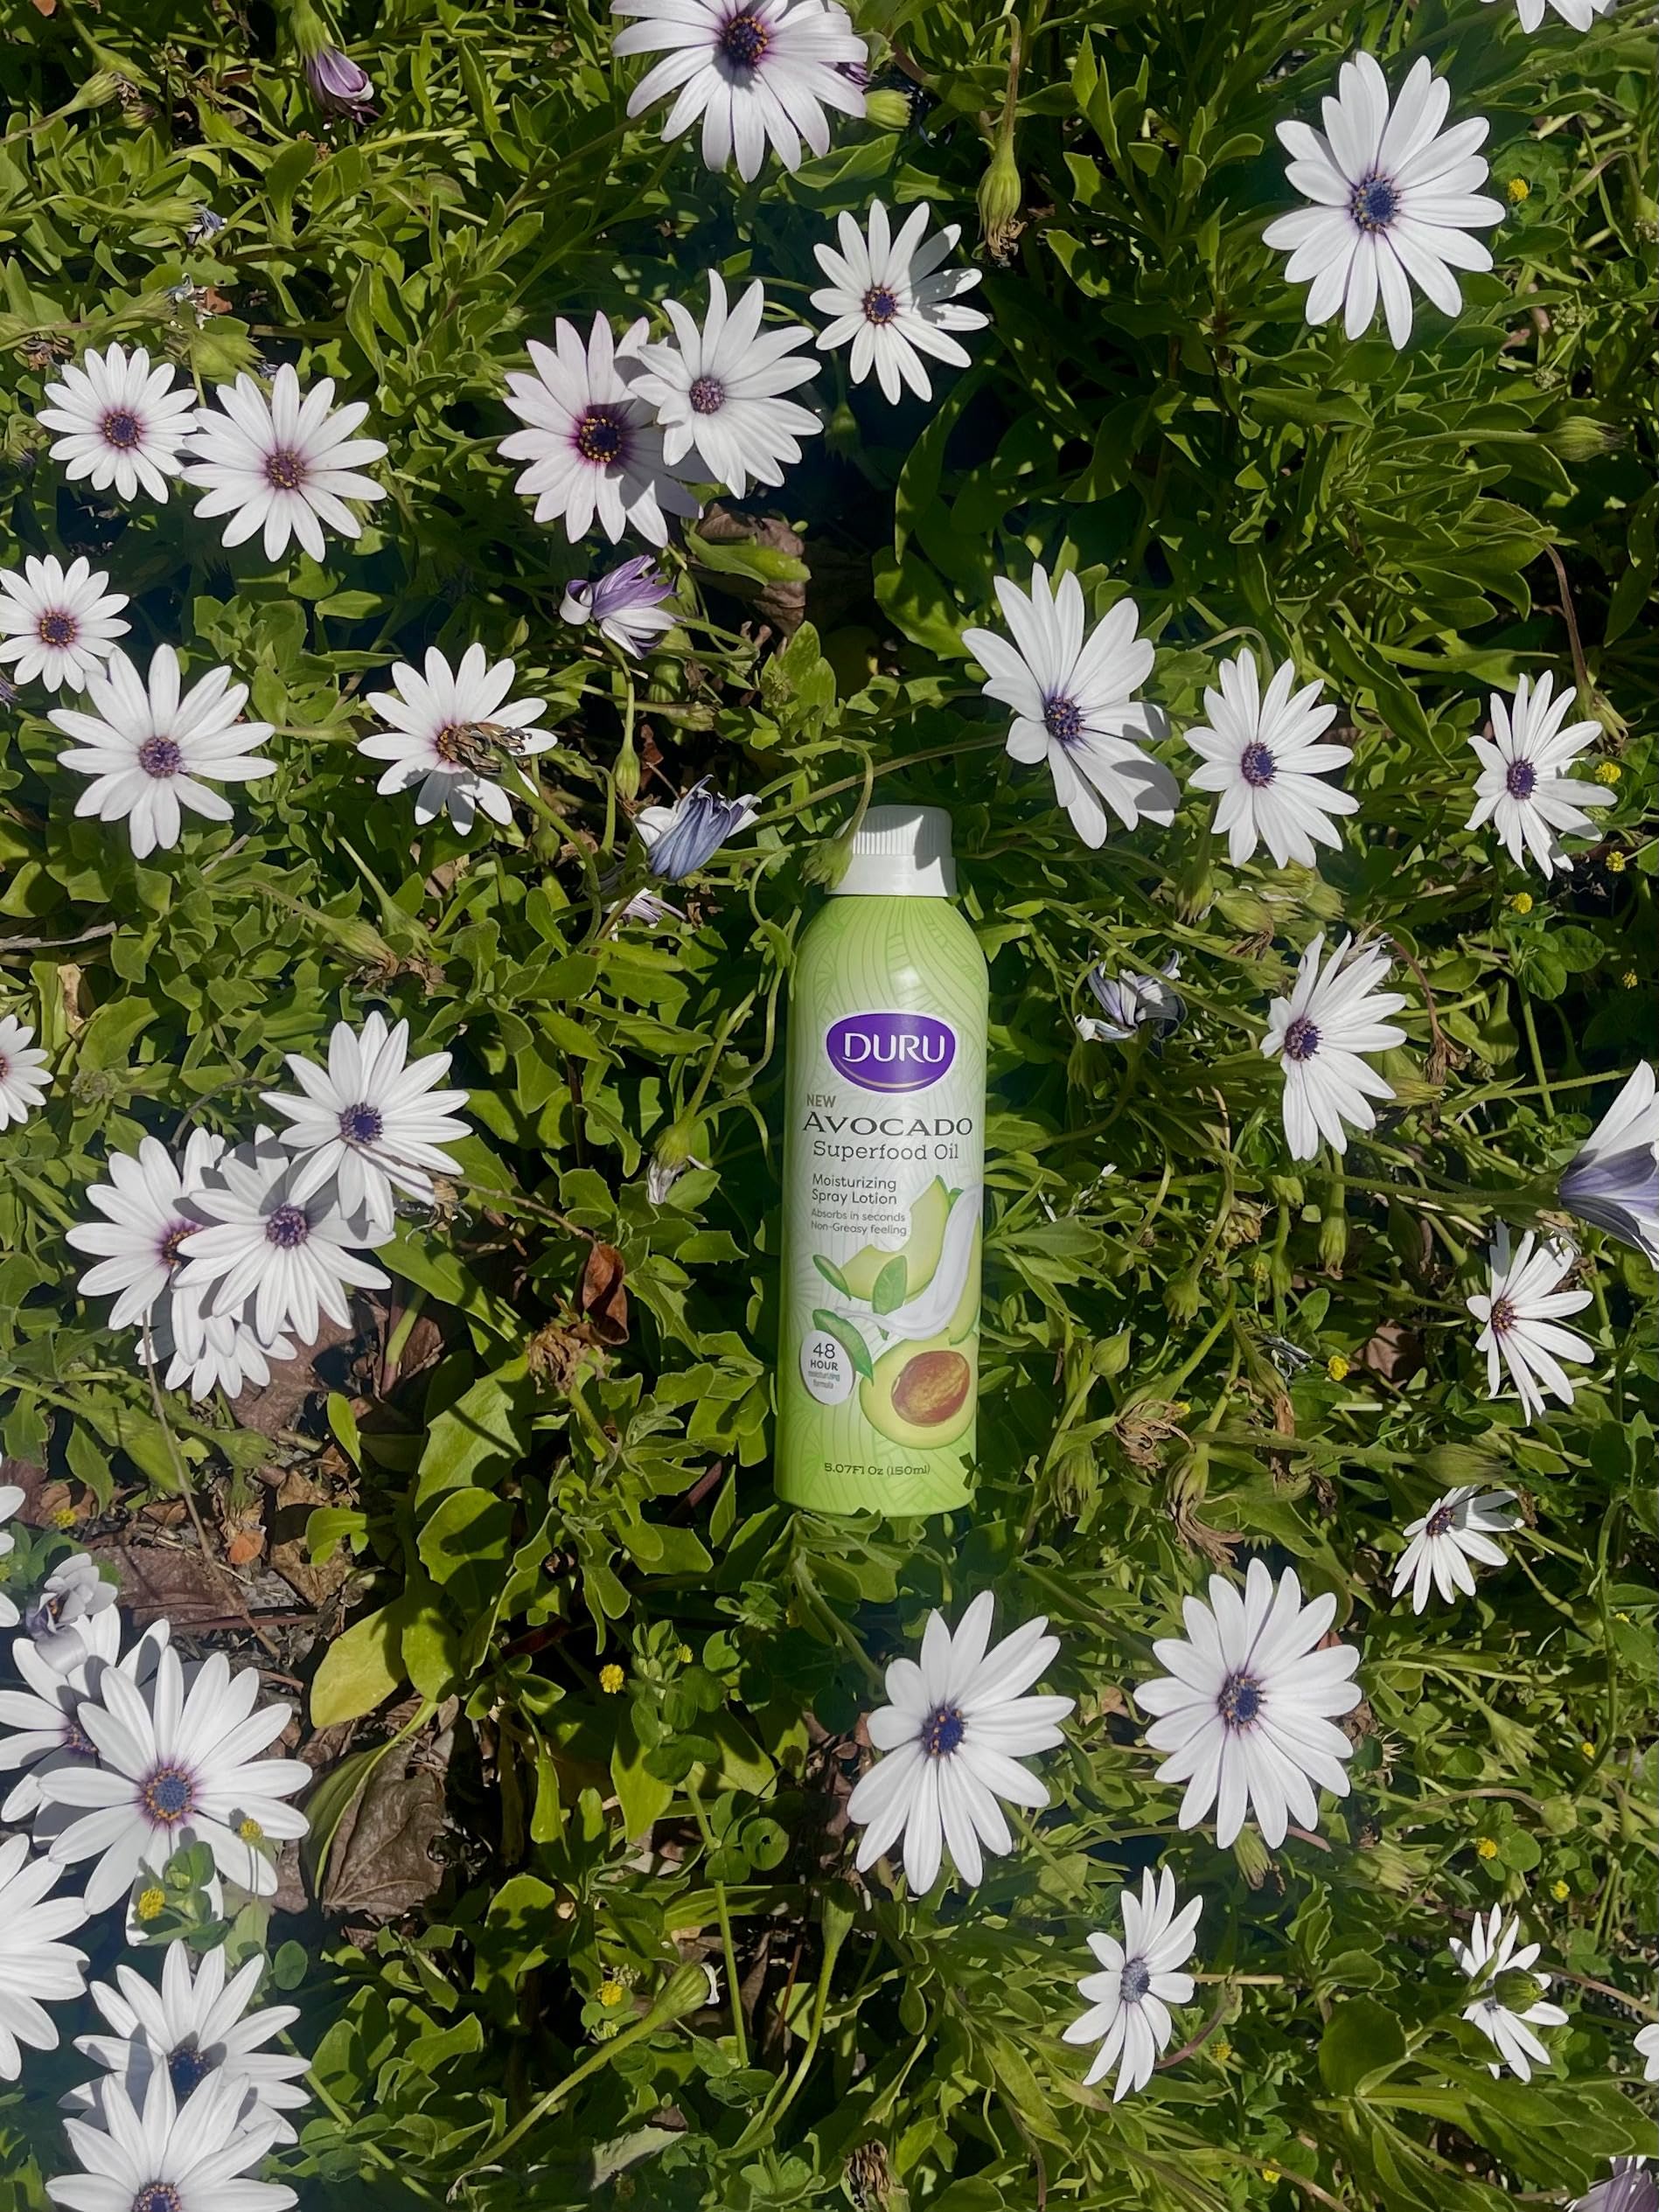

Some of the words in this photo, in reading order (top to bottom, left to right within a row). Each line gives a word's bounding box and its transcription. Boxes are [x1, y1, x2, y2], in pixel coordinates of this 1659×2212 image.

[841, 1033, 945, 1063] DURU
[806, 1094, 836, 1108] NEW
[802, 1111, 973, 1137] AVOCADO
[813, 1141, 927, 1161] Superfood
[934, 1143, 958, 1159] Oil
[812, 1173, 896, 1192] Moisturizing
[812, 1189, 847, 1205] Spray
[852, 1192, 897, 1205] Lotion
[811, 1208, 847, 1221] Absorbs
[850, 1212, 859, 1221] in
[861, 1212, 906, 1222] seconds
[811, 1221, 868, 1235] Non-Greasy
[870, 1226, 907, 1237] feeling
[813, 1343, 835, 1359] 48
[810, 1360, 838, 1371] HOUR
[886, 1464, 931, 1477] (150ml)
